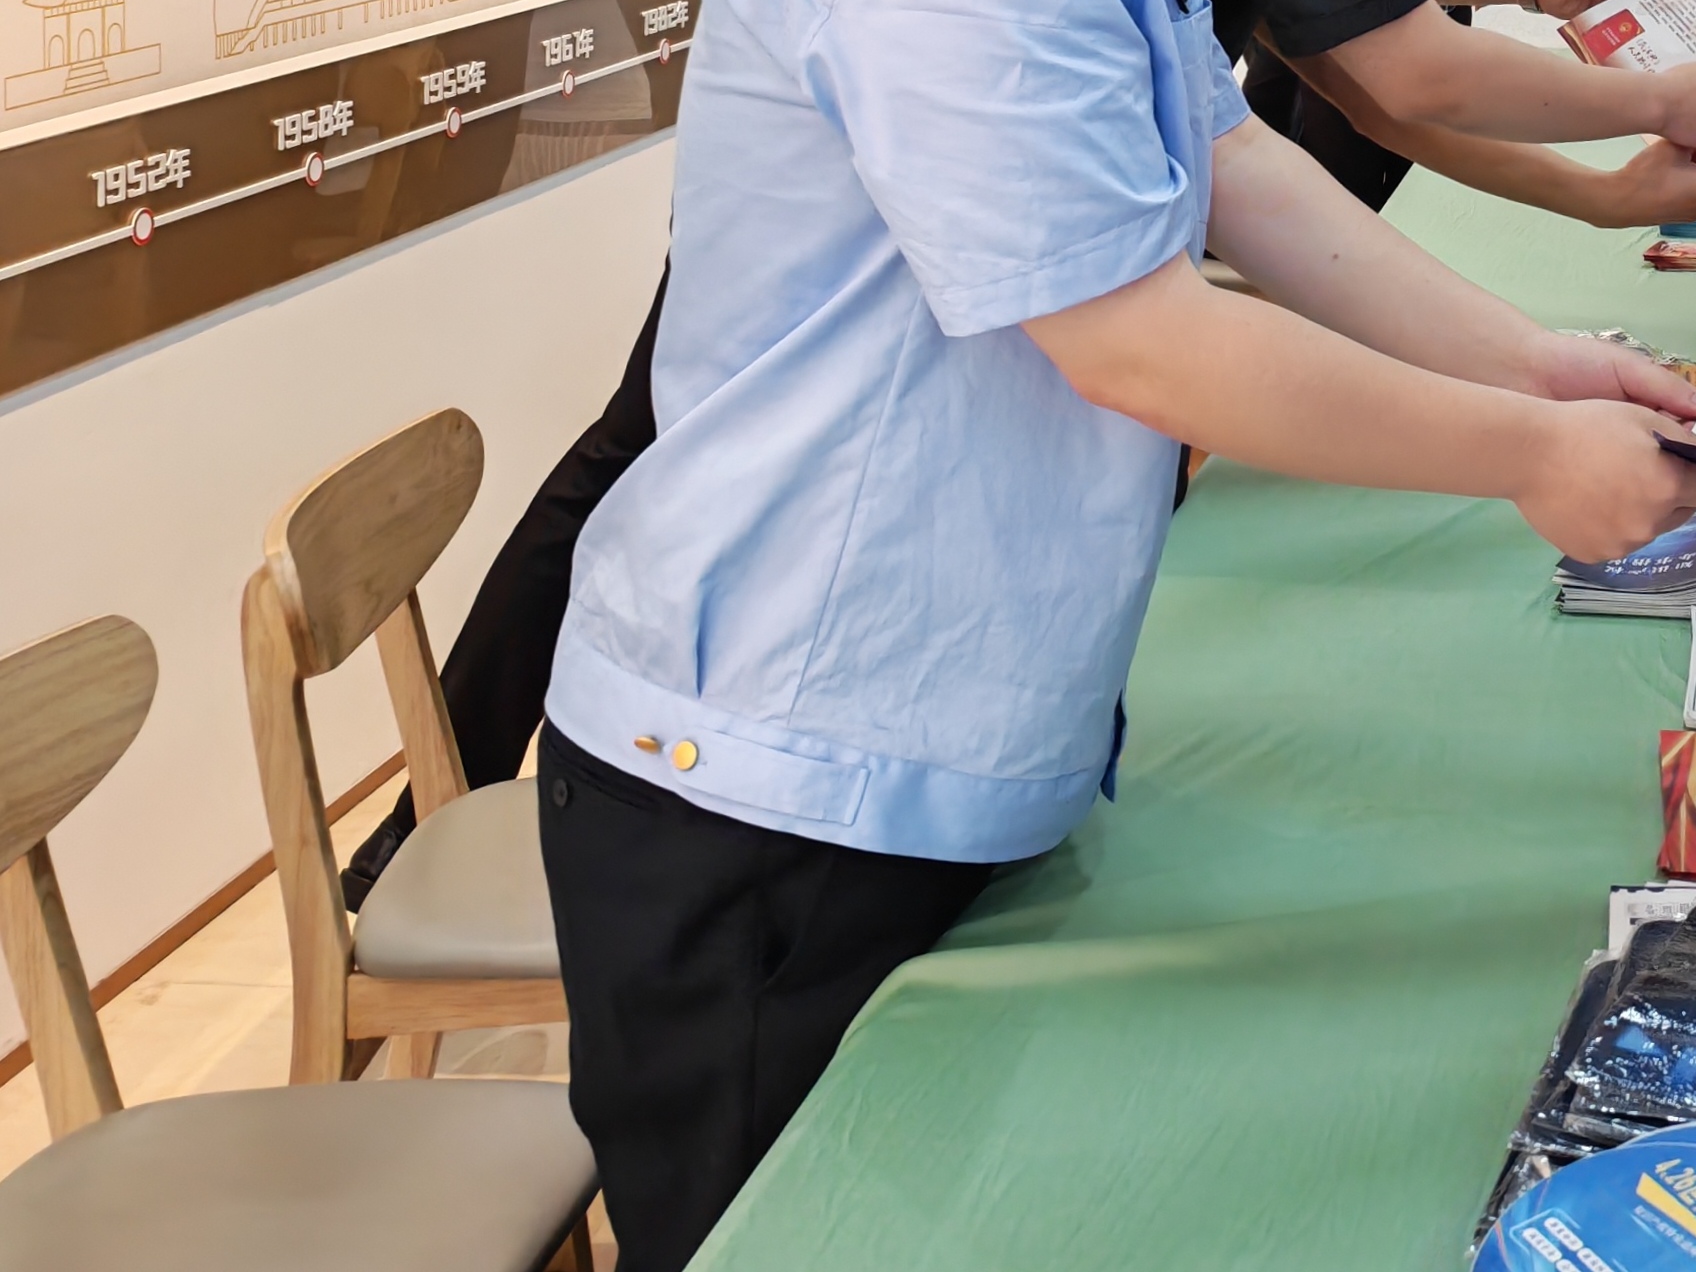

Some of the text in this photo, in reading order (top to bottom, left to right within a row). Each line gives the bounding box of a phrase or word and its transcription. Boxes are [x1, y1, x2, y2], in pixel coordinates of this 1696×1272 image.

[641, 1, 689, 36] 1982年
[542, 29, 594, 67] 1961年
[420, 61, 486, 105] 1959年
[272, 101, 353, 151] 1958年
[91, 149, 191, 207] 1952年
